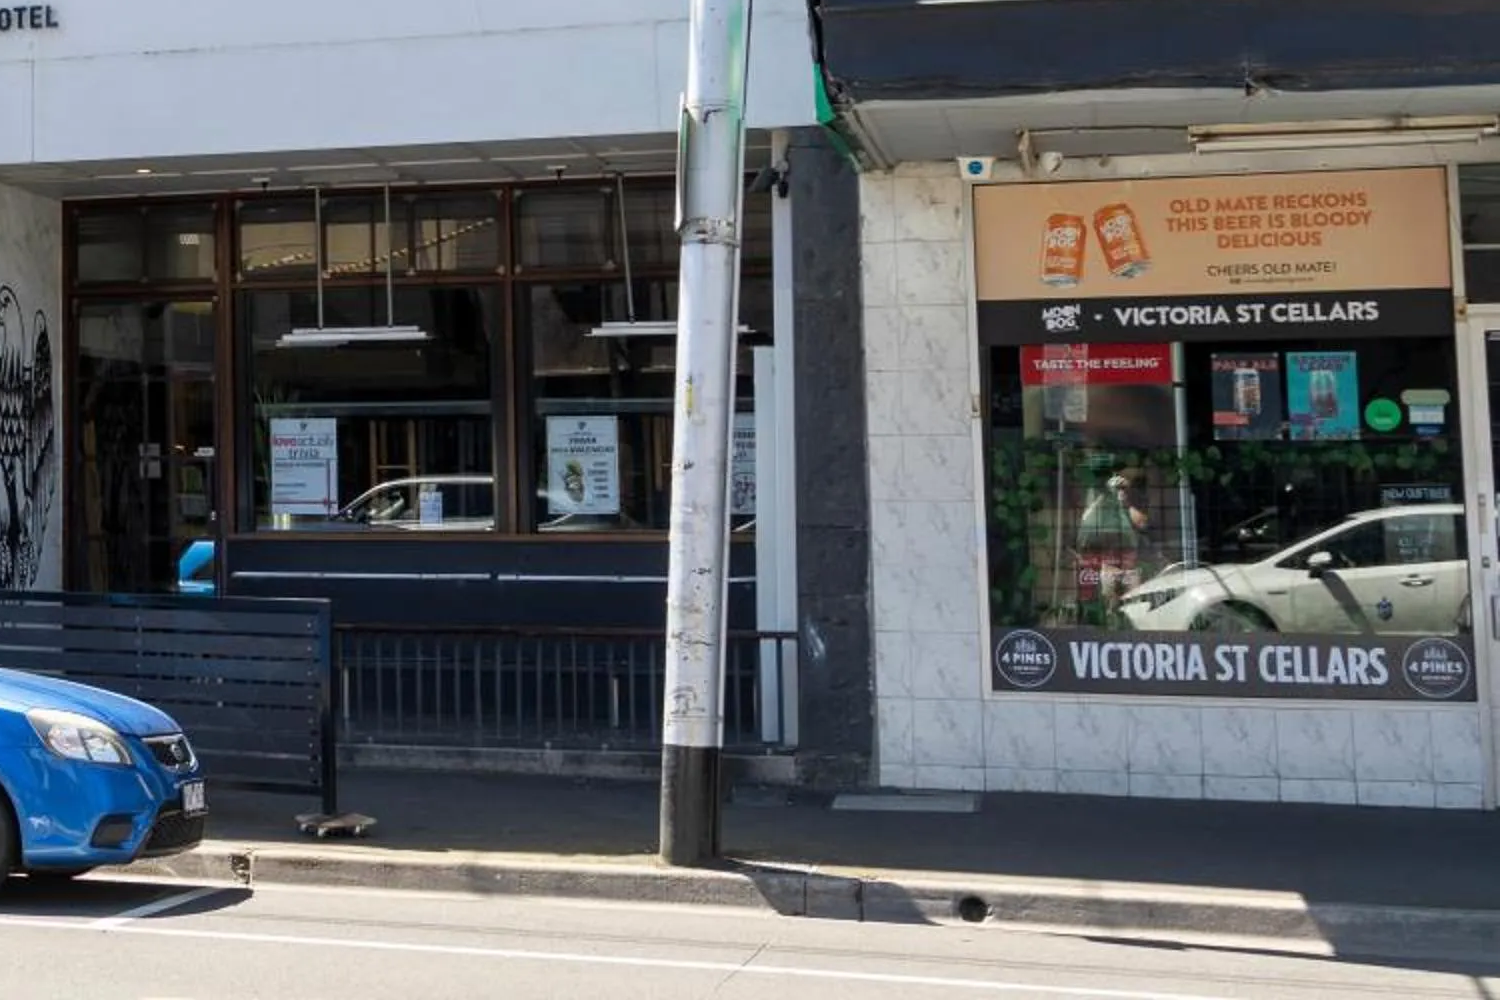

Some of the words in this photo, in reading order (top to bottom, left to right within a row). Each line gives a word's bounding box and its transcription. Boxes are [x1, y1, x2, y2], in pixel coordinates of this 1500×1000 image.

[1169, 197, 1210, 214] OLD
[1215, 195, 1268, 212] MATE
[1273, 191, 1368, 210] RECKONS
[1165, 217, 1208, 232] THIS
[1213, 214, 1261, 231] BEER
[1268, 213, 1284, 228] IS
[1290, 209, 1373, 227] BLOODY
[1217, 231, 1322, 249] DELICIOUS
[1206, 263, 1259, 278] CHEERS
[1262, 263, 1291, 276] OLD
[1295, 261, 1337, 274] MATE!
[1114, 304, 1231, 327] VICTORIA
[1236, 303, 1262, 323] ST
[1270, 300, 1380, 323] CELLARS
[1033, 359, 1073, 370] TASTE
[1076, 358, 1101, 370] THE
[1104, 357, 1160, 369] FEELING
[1012, 652, 1051, 665] PINES
[1070, 642, 1208, 681] VICTORIA
[1214, 645, 1249, 683] ST
[1259, 645, 1390, 686] CELLARS
[1420, 661, 1464, 674] PINES
